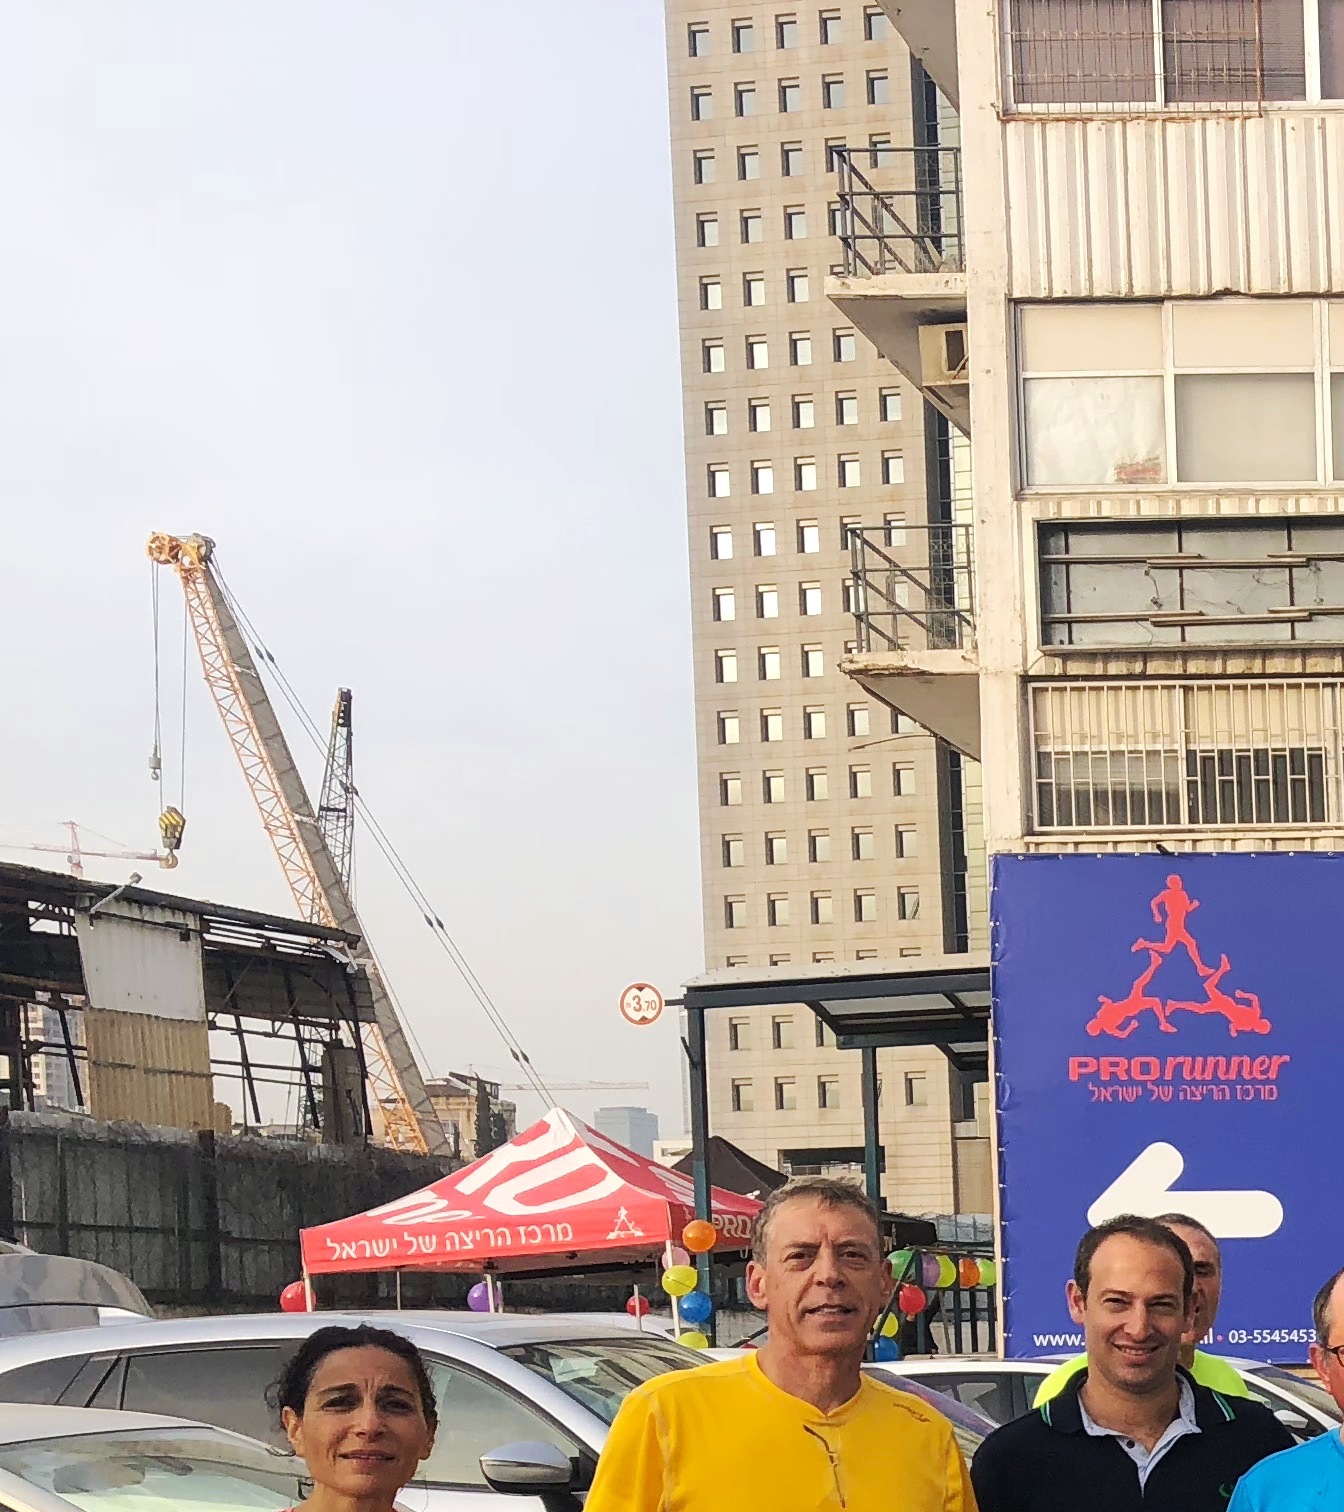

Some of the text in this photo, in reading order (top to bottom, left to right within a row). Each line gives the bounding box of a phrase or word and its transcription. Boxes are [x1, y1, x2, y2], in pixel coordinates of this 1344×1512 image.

[1088, 1081, 1278, 1102] מרכז הריצה של ישראל
[326, 1221, 573, 1261] מרכז הריצה של ישראל
[1228, 1329, 1317, 1344] 03-5545453
